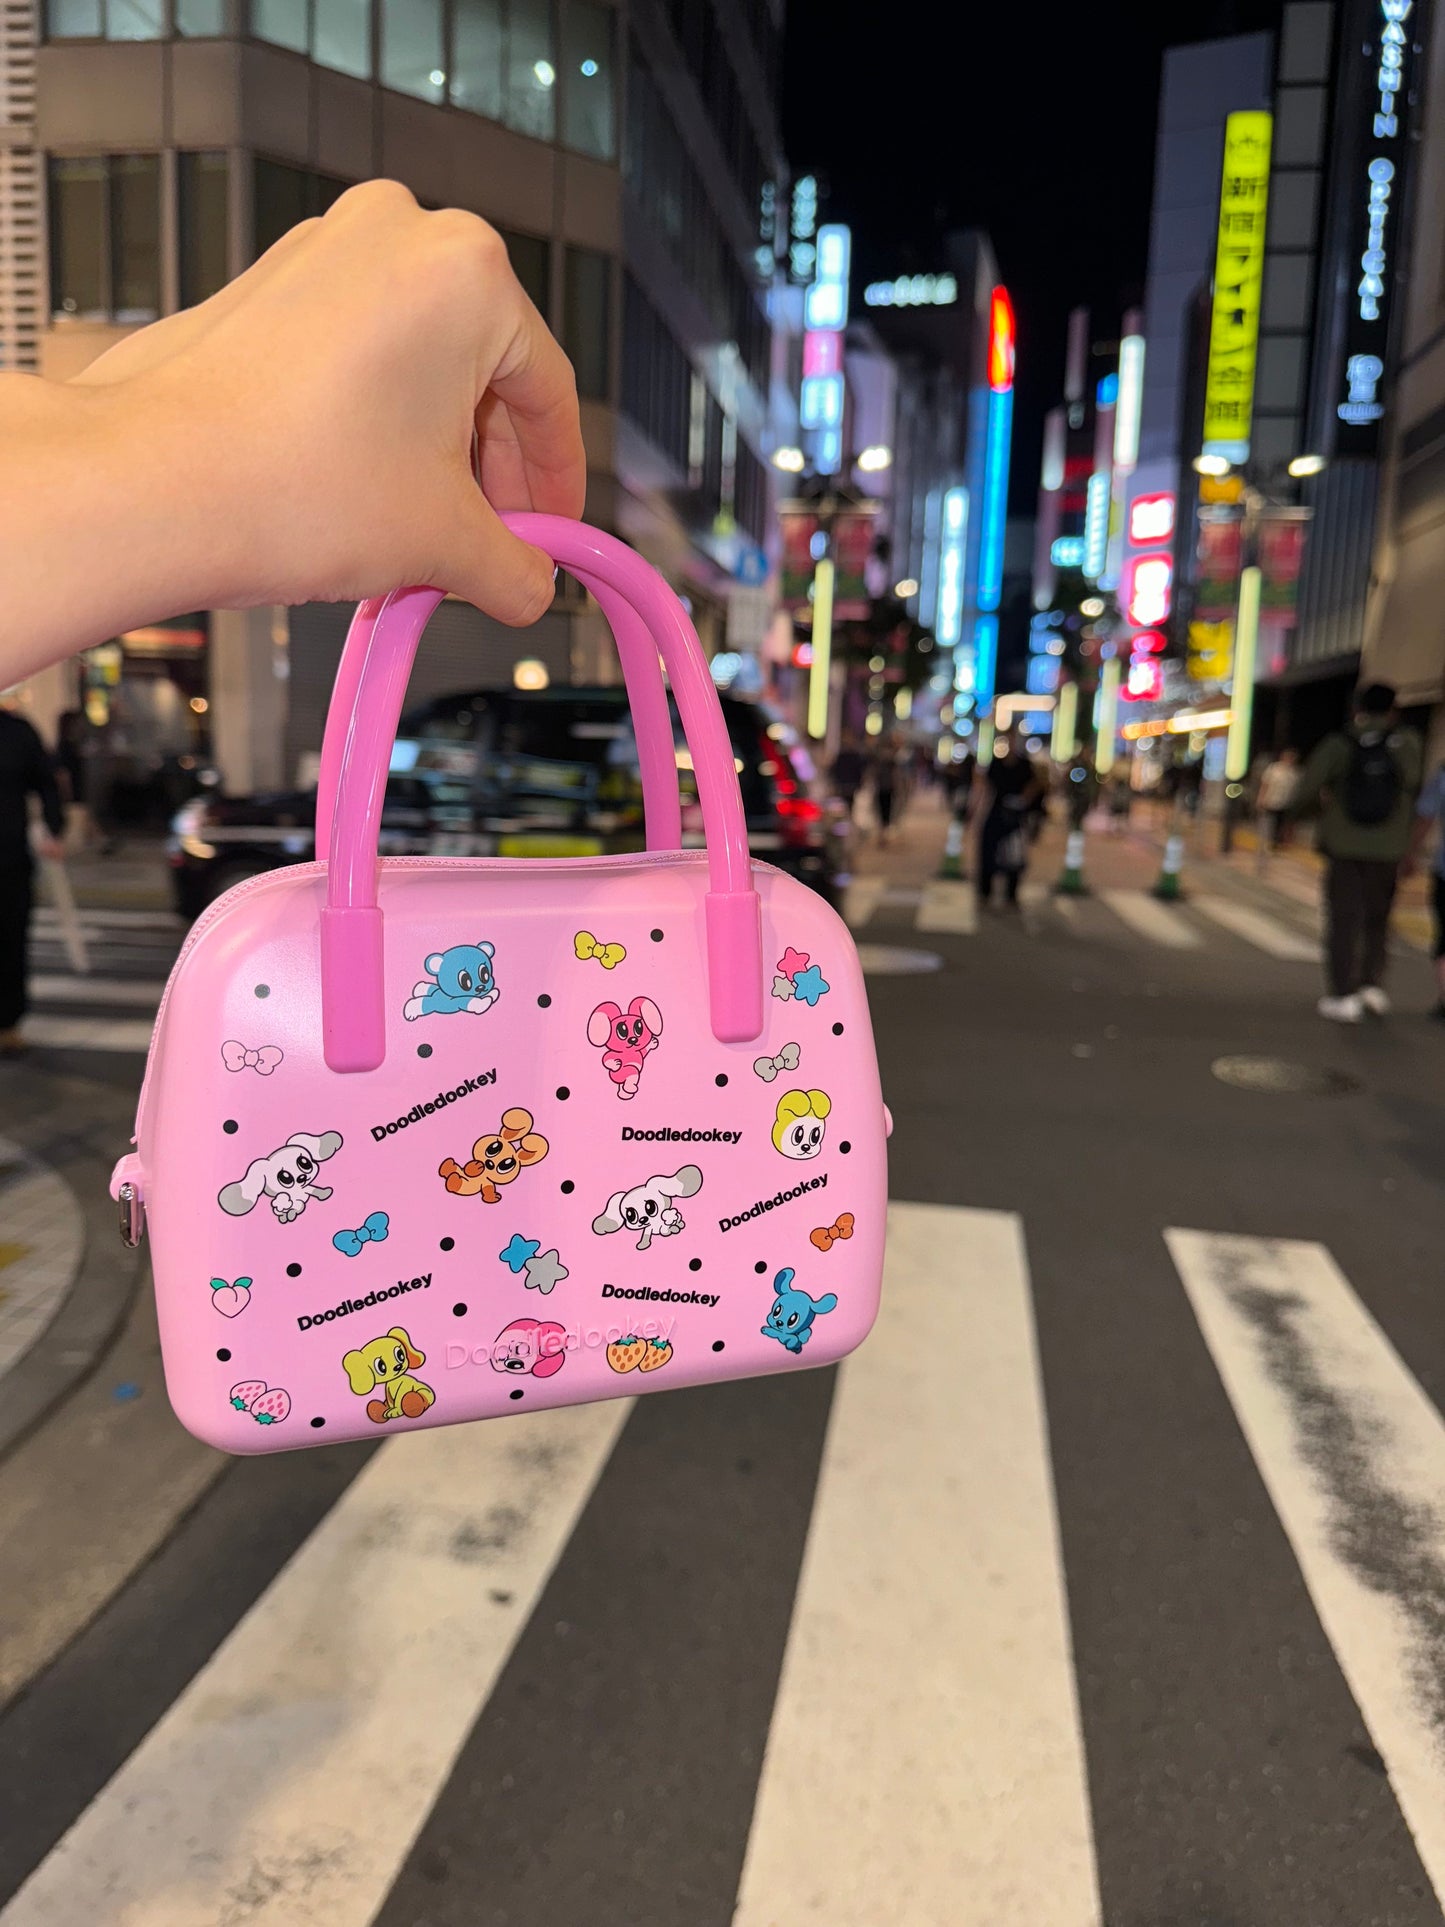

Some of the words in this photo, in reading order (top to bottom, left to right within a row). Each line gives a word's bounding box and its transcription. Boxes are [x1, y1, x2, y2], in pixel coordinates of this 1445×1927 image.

[1358, 157, 1394, 320] OPTICAL
[369, 1067, 498, 1142] Doodledookey
[621, 1126, 743, 1144] Doodledookey
[718, 1173, 828, 1233] Doodledookey
[297, 1272, 433, 1332] Doodledookey
[601, 1283, 722, 1308] Doodledookey
[444, 1315, 678, 1370] Doodledookey
